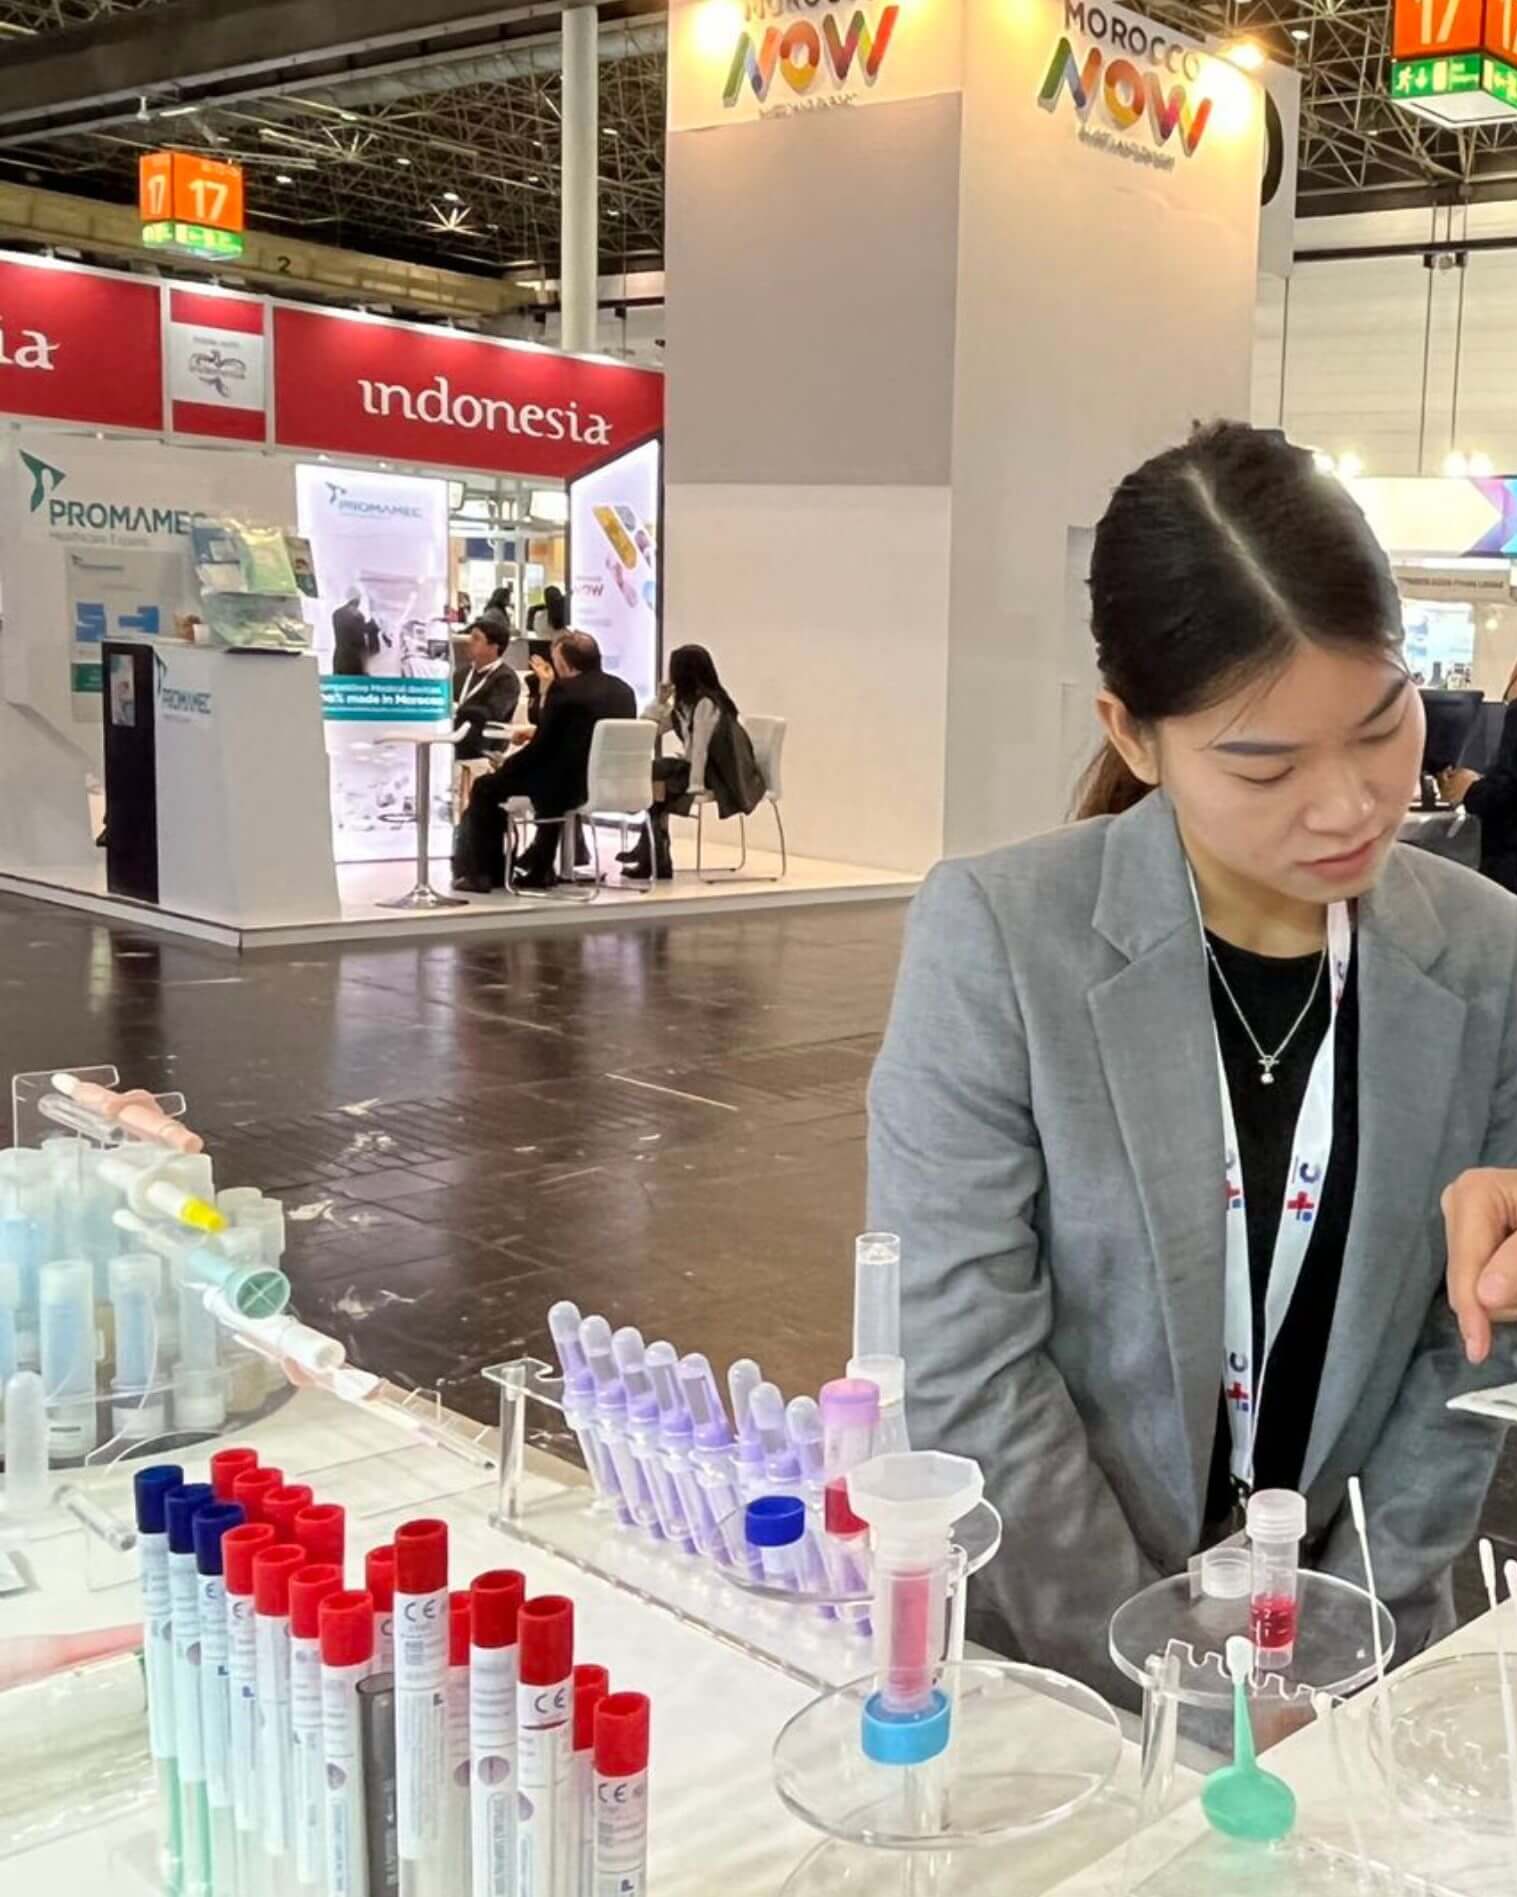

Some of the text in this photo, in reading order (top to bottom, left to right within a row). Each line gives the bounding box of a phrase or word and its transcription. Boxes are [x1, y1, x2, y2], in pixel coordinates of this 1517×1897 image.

[722, 5, 900, 108] NOW
[1064, 0, 1200, 82] MOROCCO
[1037, 36, 1213, 158] NOW
[188, 178, 229, 222] 17
[276, 256, 291, 273] 2
[357, 375, 614, 446] indonesia
